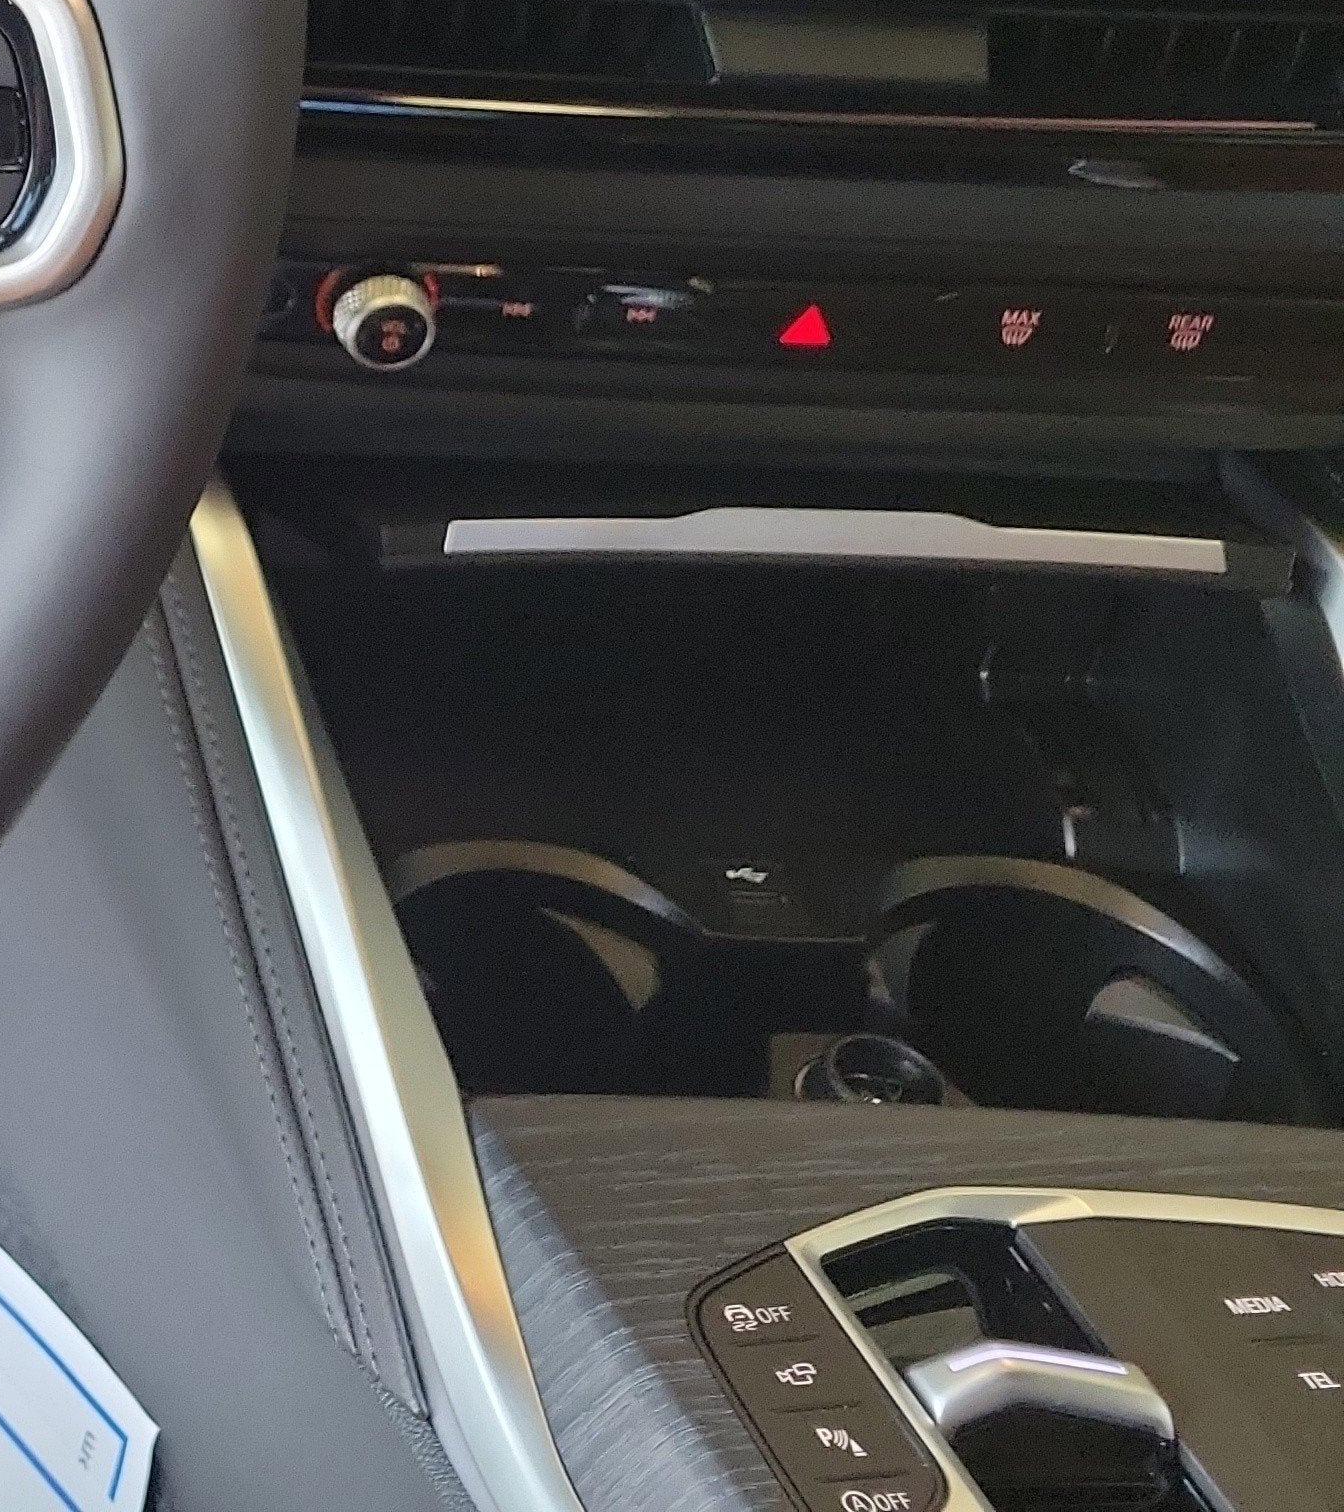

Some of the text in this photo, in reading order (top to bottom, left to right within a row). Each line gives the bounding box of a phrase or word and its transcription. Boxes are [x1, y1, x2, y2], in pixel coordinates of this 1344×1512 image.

[1000, 308, 1043, 325] MAX
[755, 1305, 792, 1324] OFF
[1224, 1296, 1293, 1315] MEDIA
[1298, 1372, 1341, 1390] TEL
[873, 1492, 912, 1512] OFF
